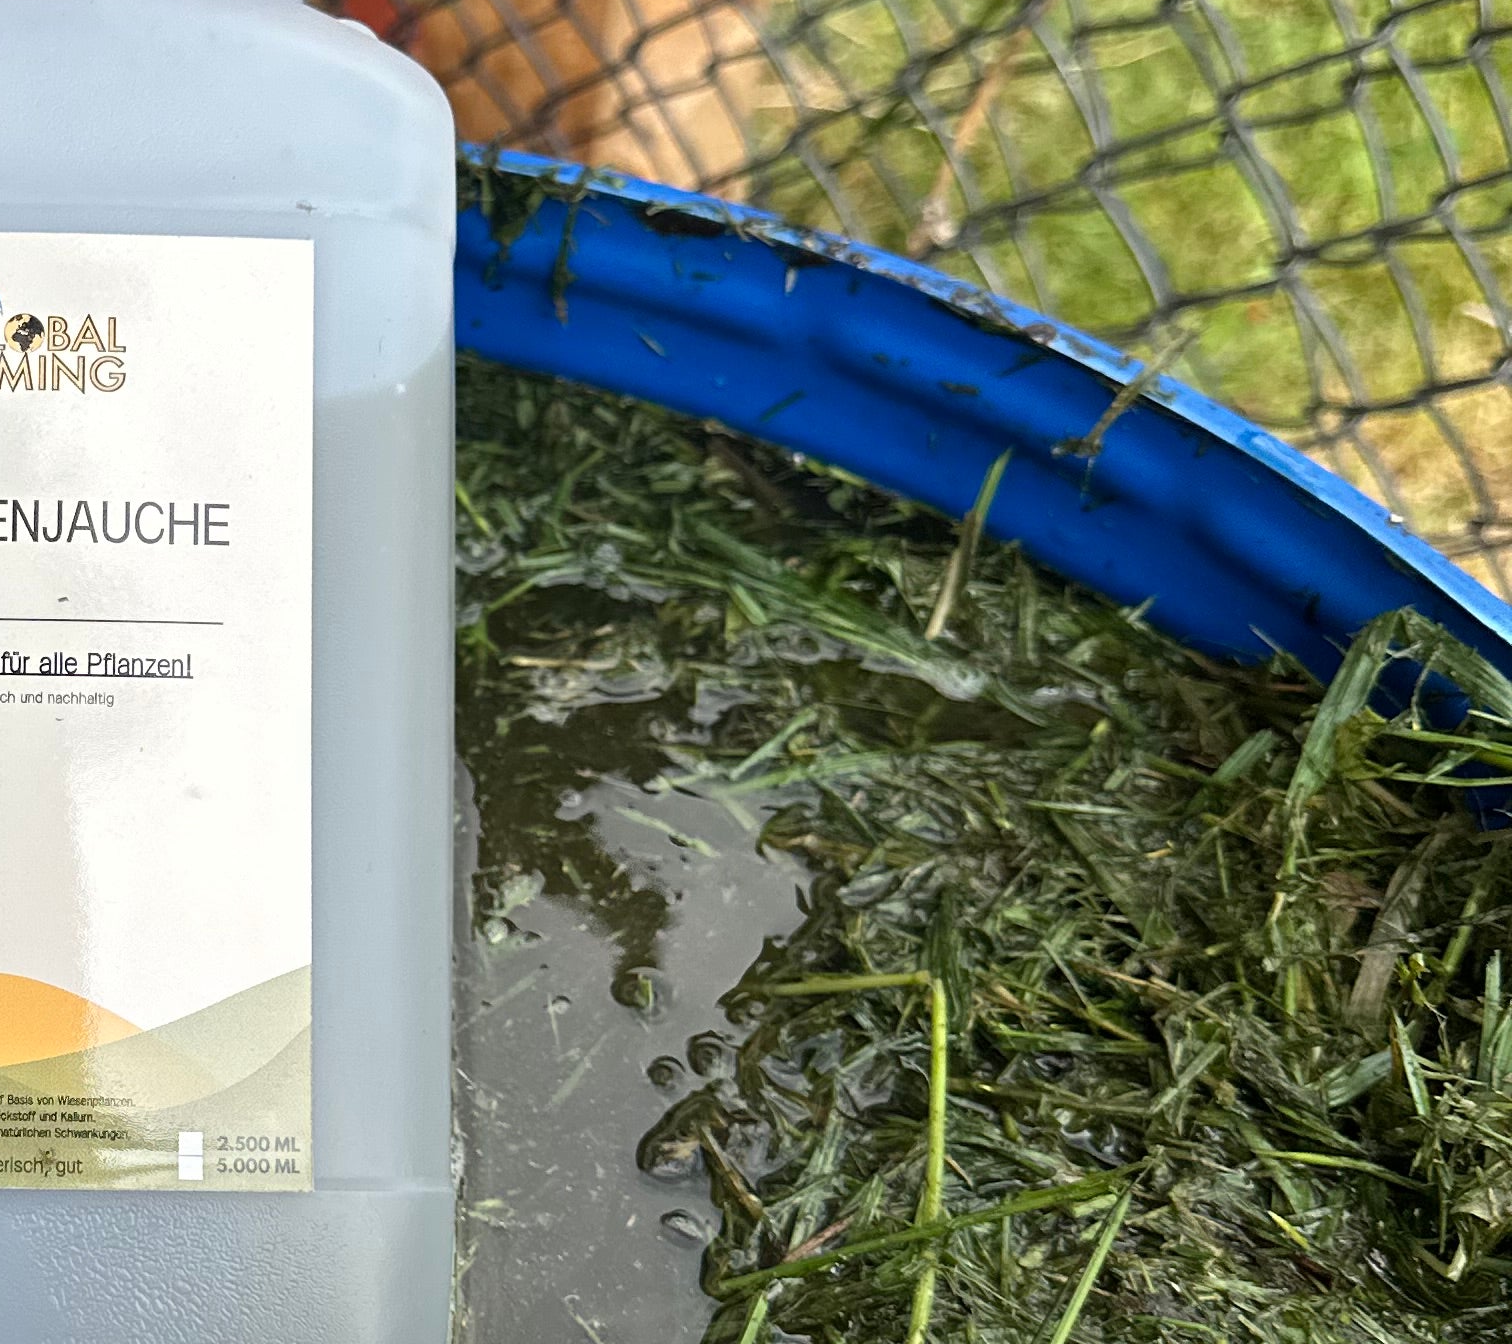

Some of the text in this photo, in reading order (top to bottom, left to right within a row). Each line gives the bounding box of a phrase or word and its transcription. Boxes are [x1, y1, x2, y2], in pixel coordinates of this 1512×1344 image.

[0, 650, 30, 675] für
[38, 652, 78, 676] alle
[87, 652, 194, 679] Pflanzen!
[20, 691, 44, 705] und
[47, 691, 115, 708] nachhaltig
[7, 1094, 33, 1105] Basis
[37, 1096, 54, 1106] von
[39, 1111, 57, 1122] und
[216, 1136, 301, 1153] 2.500 ML
[56, 1157, 84, 1177] gut
[216, 1157, 301, 1175] 5.000 ML
